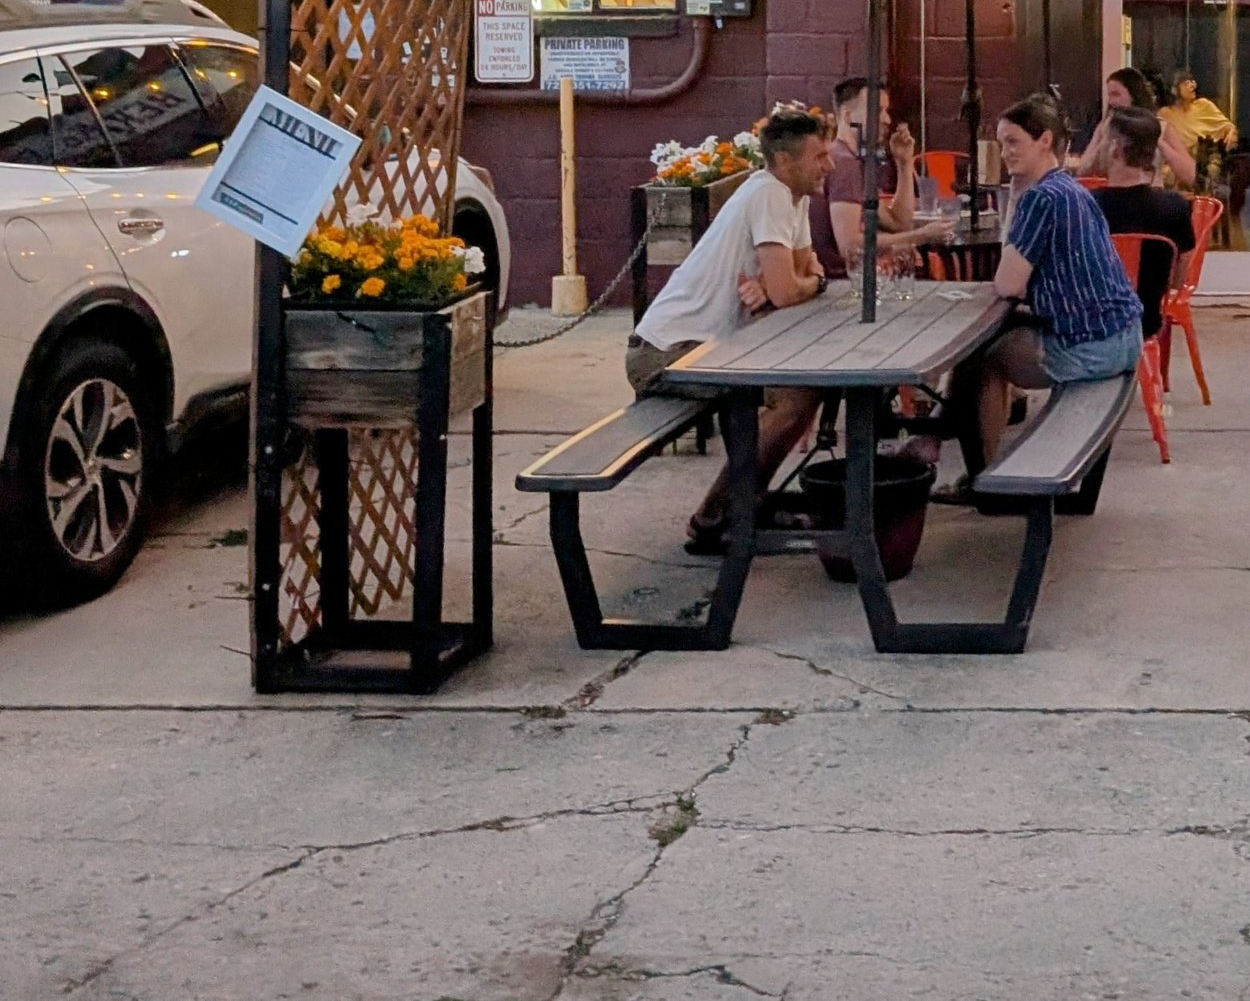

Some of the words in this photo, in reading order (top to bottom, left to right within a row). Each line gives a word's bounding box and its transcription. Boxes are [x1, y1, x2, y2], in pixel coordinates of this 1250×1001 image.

[479, 0, 493, 14] NO
[496, 1, 528, 11] PARKING
[483, 22, 498, 30] THIS
[502, 22, 525, 30] SPACE
[485, 33, 523, 41] RESERVED
[545, 39, 581, 50] PRIVATE
[584, 39, 624, 50] PARKING
